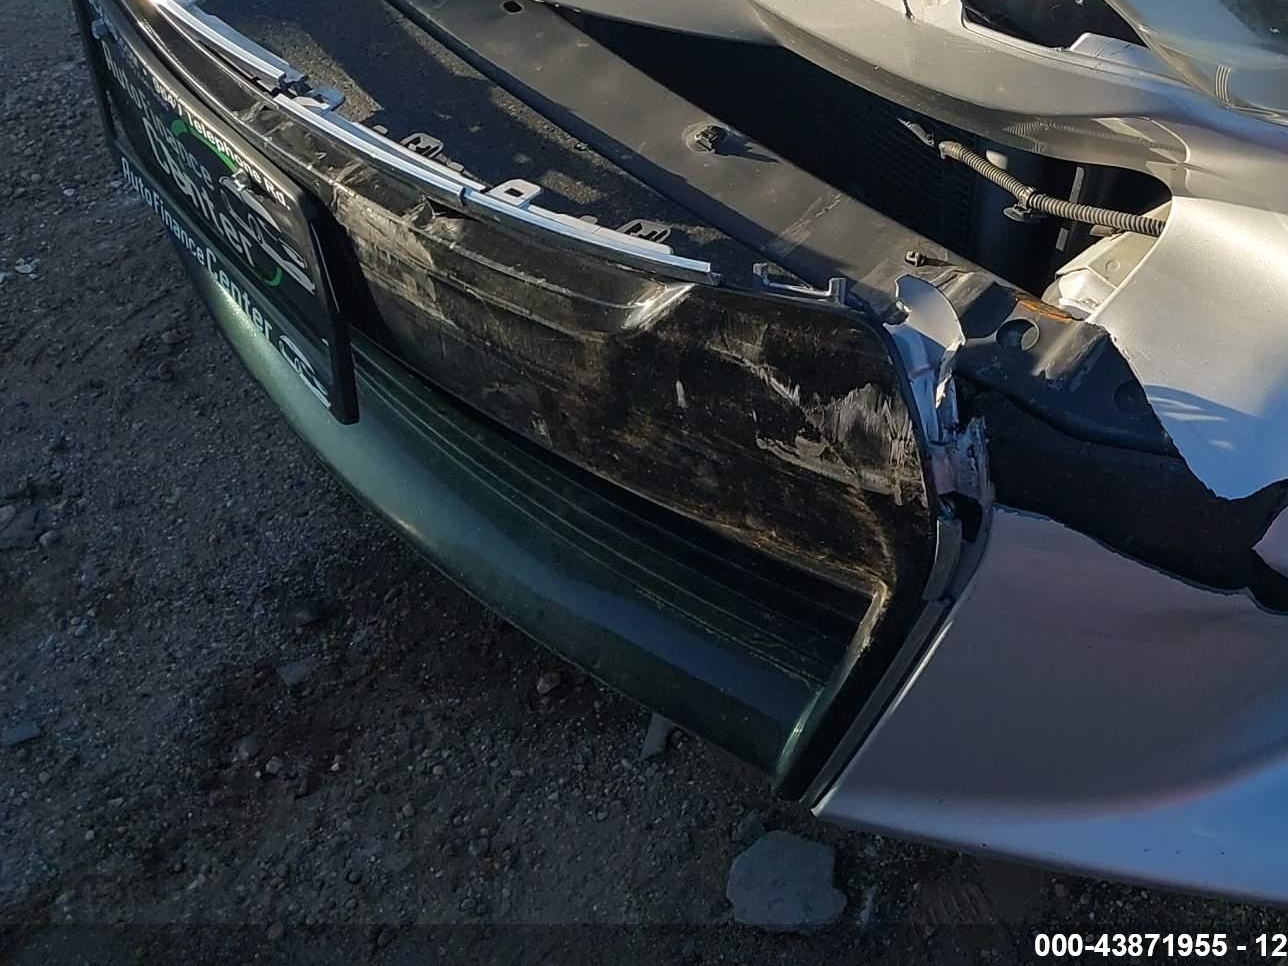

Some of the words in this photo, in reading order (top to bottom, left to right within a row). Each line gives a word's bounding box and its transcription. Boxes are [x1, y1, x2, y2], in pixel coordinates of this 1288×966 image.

[143, 115, 255, 267] Center
[183, 107, 263, 185] Telephone
[264, 179, 291, 210] Rd.
